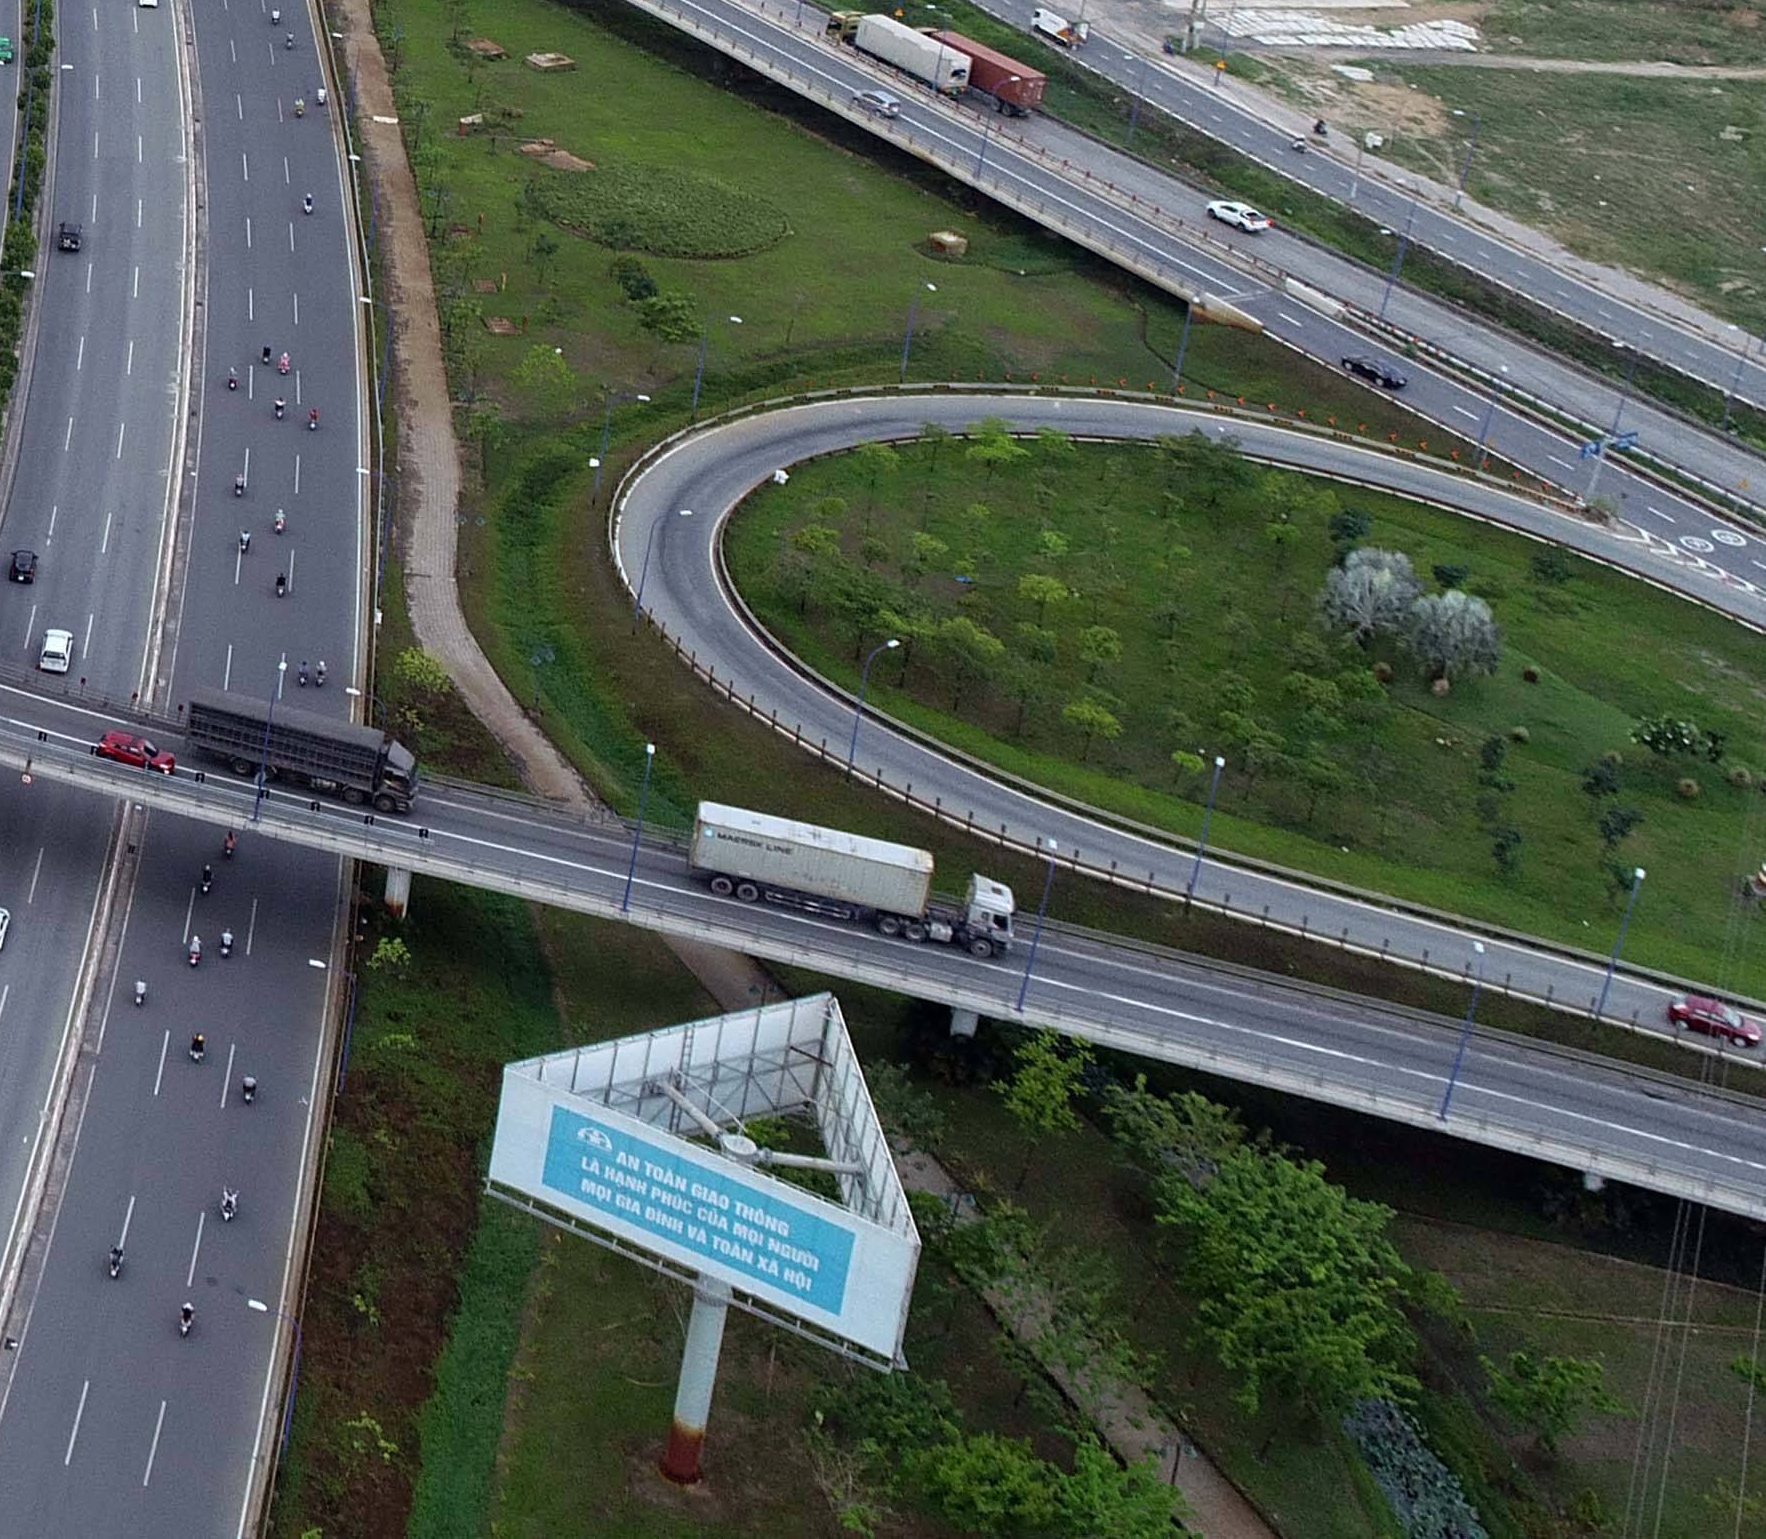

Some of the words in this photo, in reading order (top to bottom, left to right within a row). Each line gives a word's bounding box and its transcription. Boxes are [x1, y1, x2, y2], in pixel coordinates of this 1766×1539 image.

[717, 833, 762, 847] MAERSK
[766, 844, 792, 855] LINE
[581, 1156, 600, 1175] LÀ
[604, 1166, 647, 1196] HẠNH
[650, 1185, 693, 1214] PHÚC
[697, 1204, 728, 1231] CỦA
[733, 1222, 763, 1246] MỌI
[768, 1237, 819, 1272] NGƯỜI
[581, 1179, 611, 1202] MỌI
[616, 1193, 640, 1215] GIA
[645, 1205, 683, 1234] ĐÌNH
[687, 1224, 707, 1245] VÀ
[712, 1235, 754, 1264] TOÀN
[757, 1254, 779, 1277] XÃ
[783, 1267, 812, 1290] HỘI
[616, 1151, 640, 1172] AN
[644, 1161, 687, 1192] TOÀN
[691, 1183, 729, 1210] GIAO
[735, 1201, 789, 1237] THÔNG
